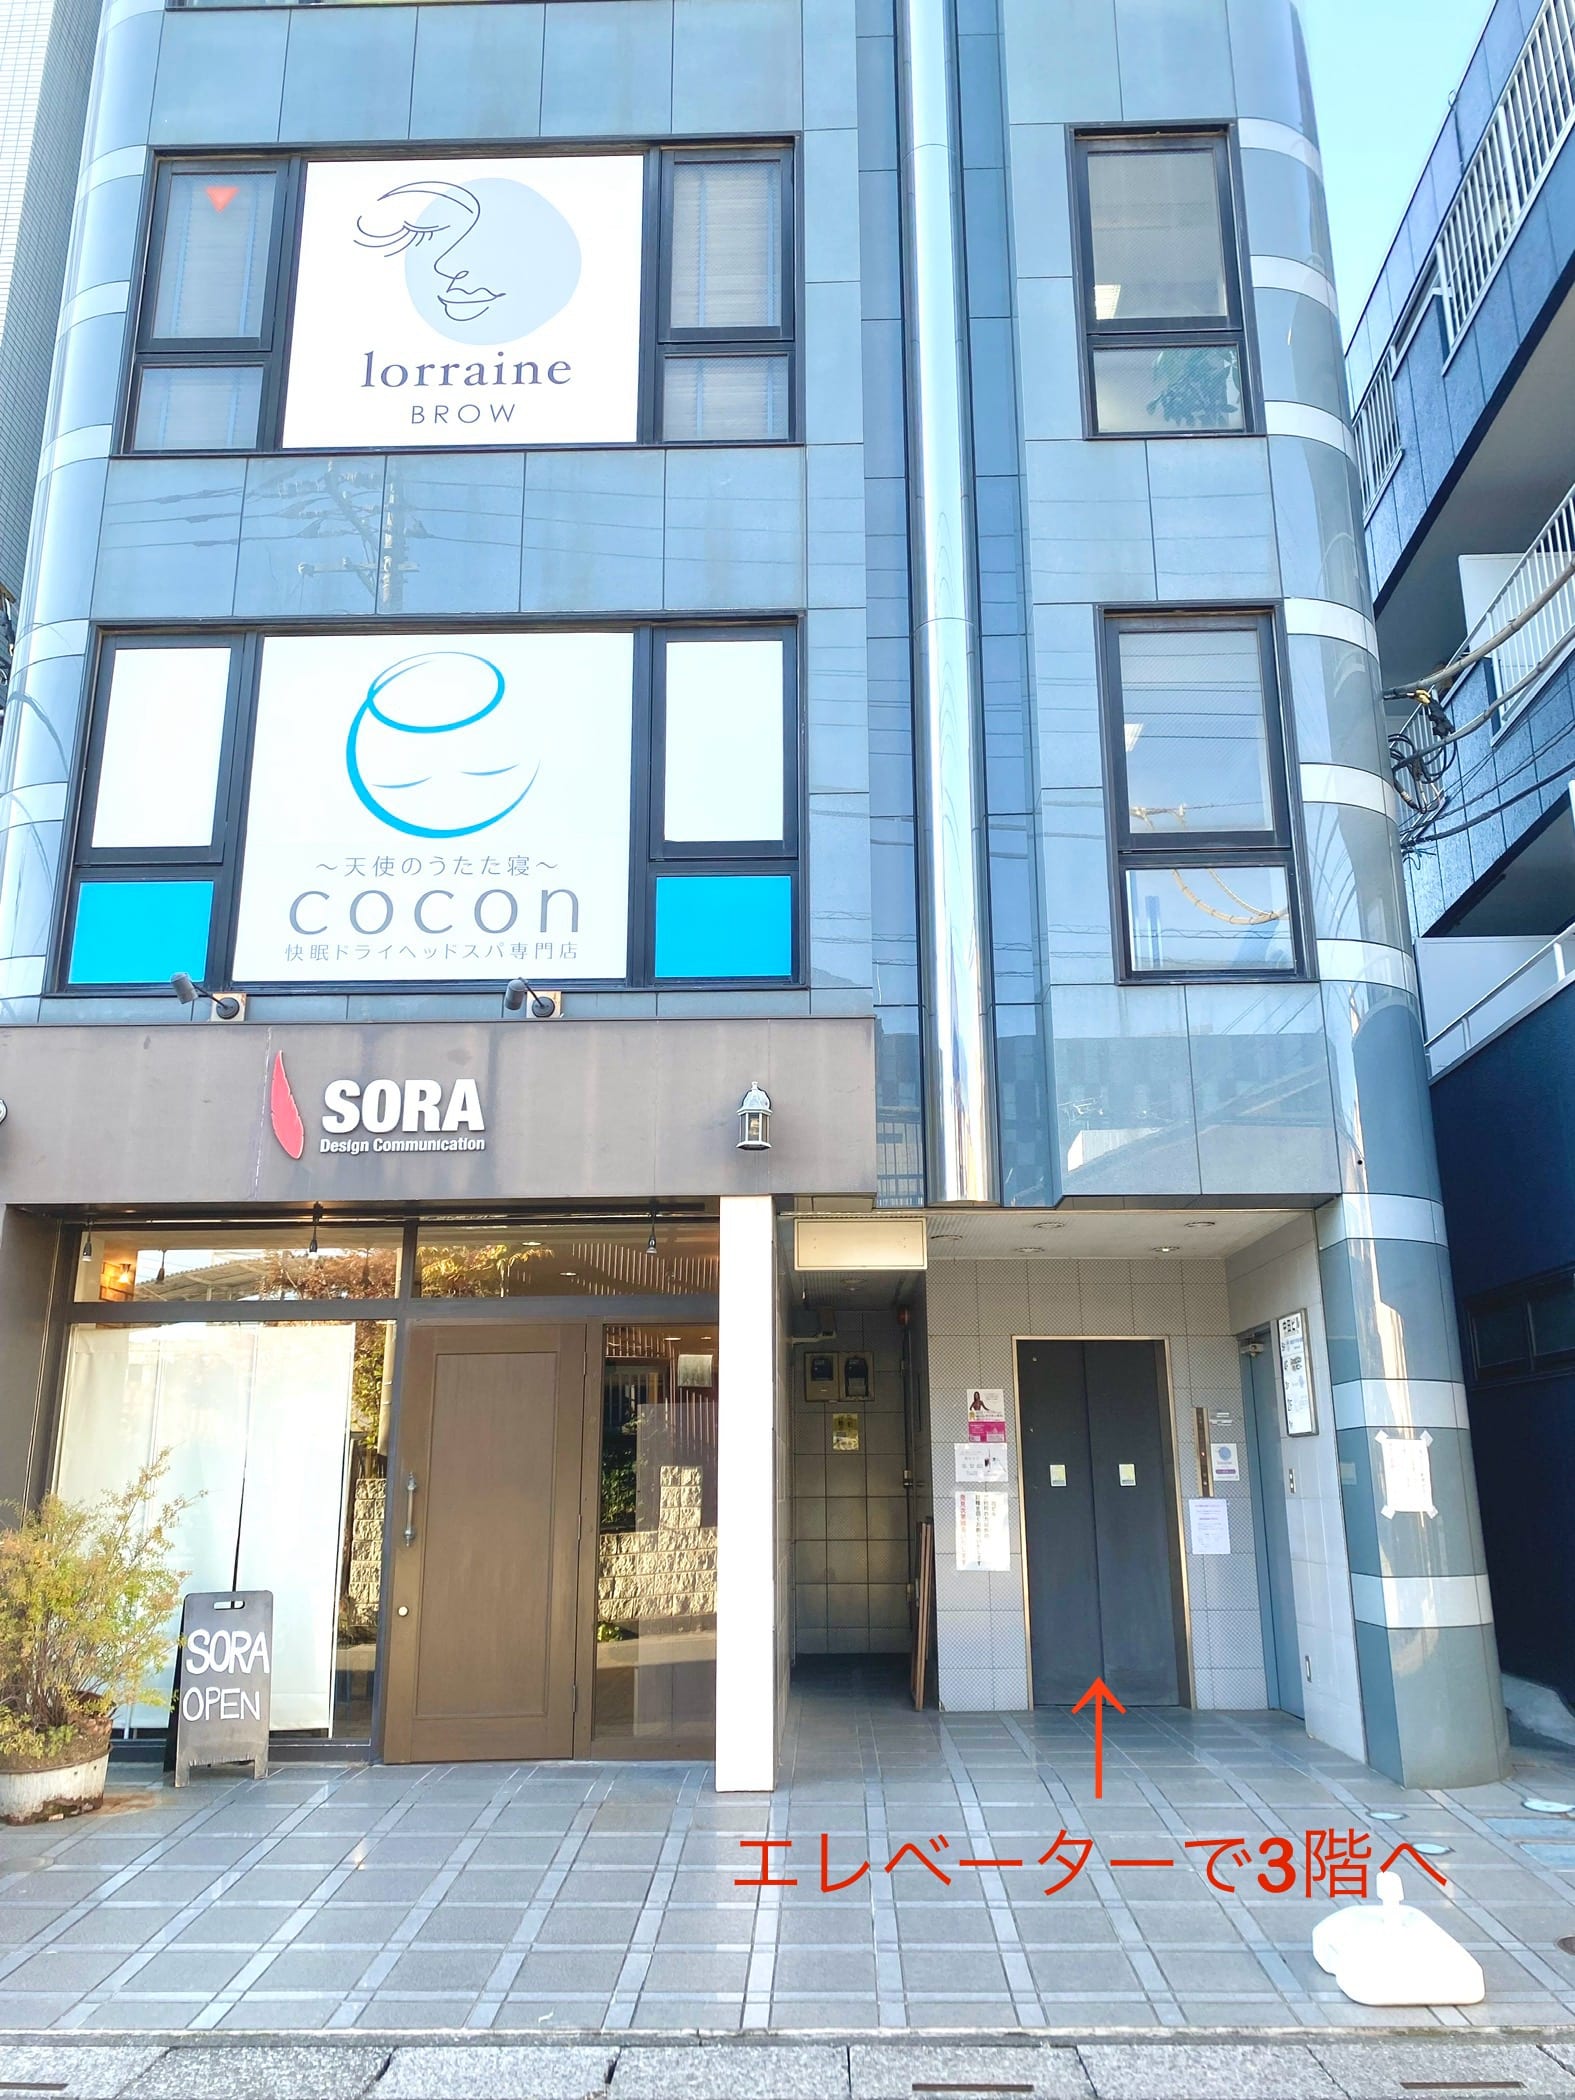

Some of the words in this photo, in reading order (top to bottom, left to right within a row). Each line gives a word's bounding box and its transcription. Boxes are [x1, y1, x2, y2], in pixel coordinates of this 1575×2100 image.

[360, 350, 572, 388] lorraine
[411, 403, 516, 425] BROW
[288, 888, 579, 936] cocon
[284, 941, 578, 962] 快眠ドライヘッドスパ専門店
[322, 1078, 485, 1134] SORA
[319, 1137, 369, 1156] Design
[372, 1137, 485, 1153] Communication
[185, 1628, 271, 1676] SORA
[181, 1686, 261, 1722] OPEN
